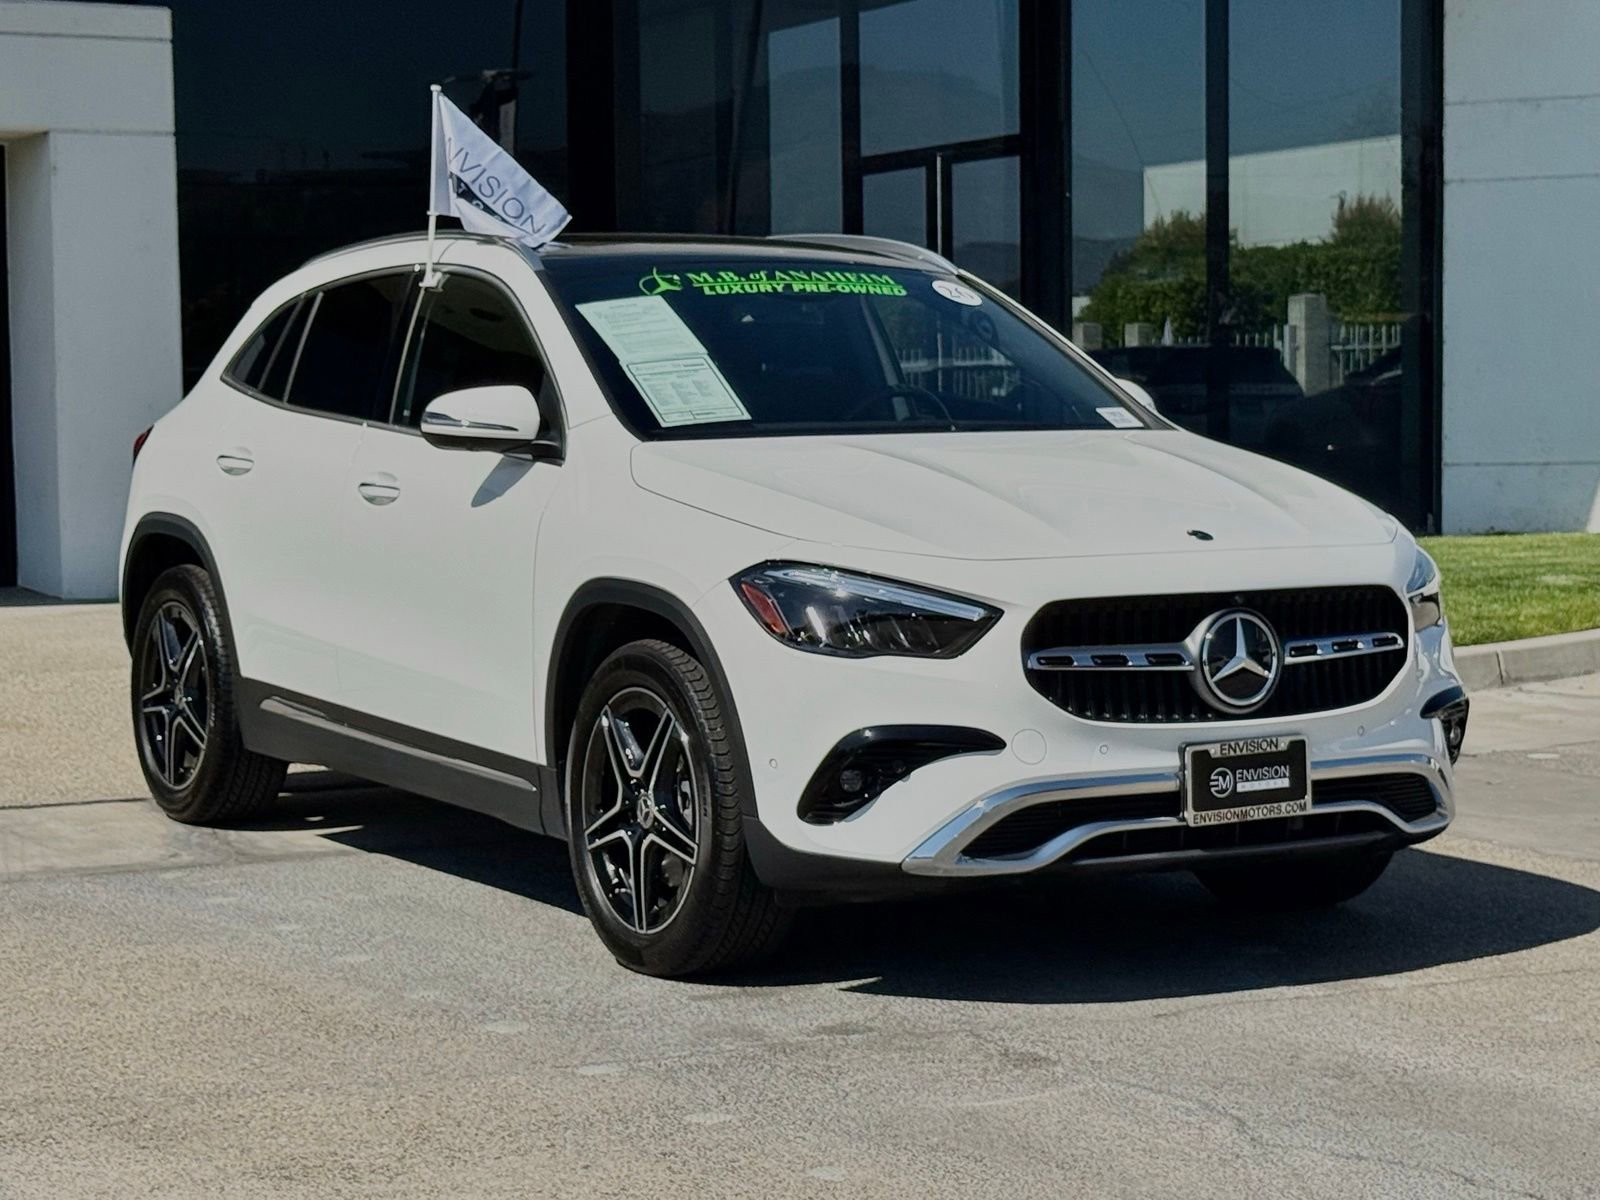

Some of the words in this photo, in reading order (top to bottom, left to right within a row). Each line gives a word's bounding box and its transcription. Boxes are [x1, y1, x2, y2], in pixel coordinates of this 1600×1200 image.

[702, 283, 785, 295] LUXURY
[791, 283, 907, 296] PRE-OWNED
[1220, 738, 1279, 756] ENVISION
[1236, 764, 1289, 781] ENVISION
[1193, 801, 1307, 825] ENVISIONMOTORS.COM
